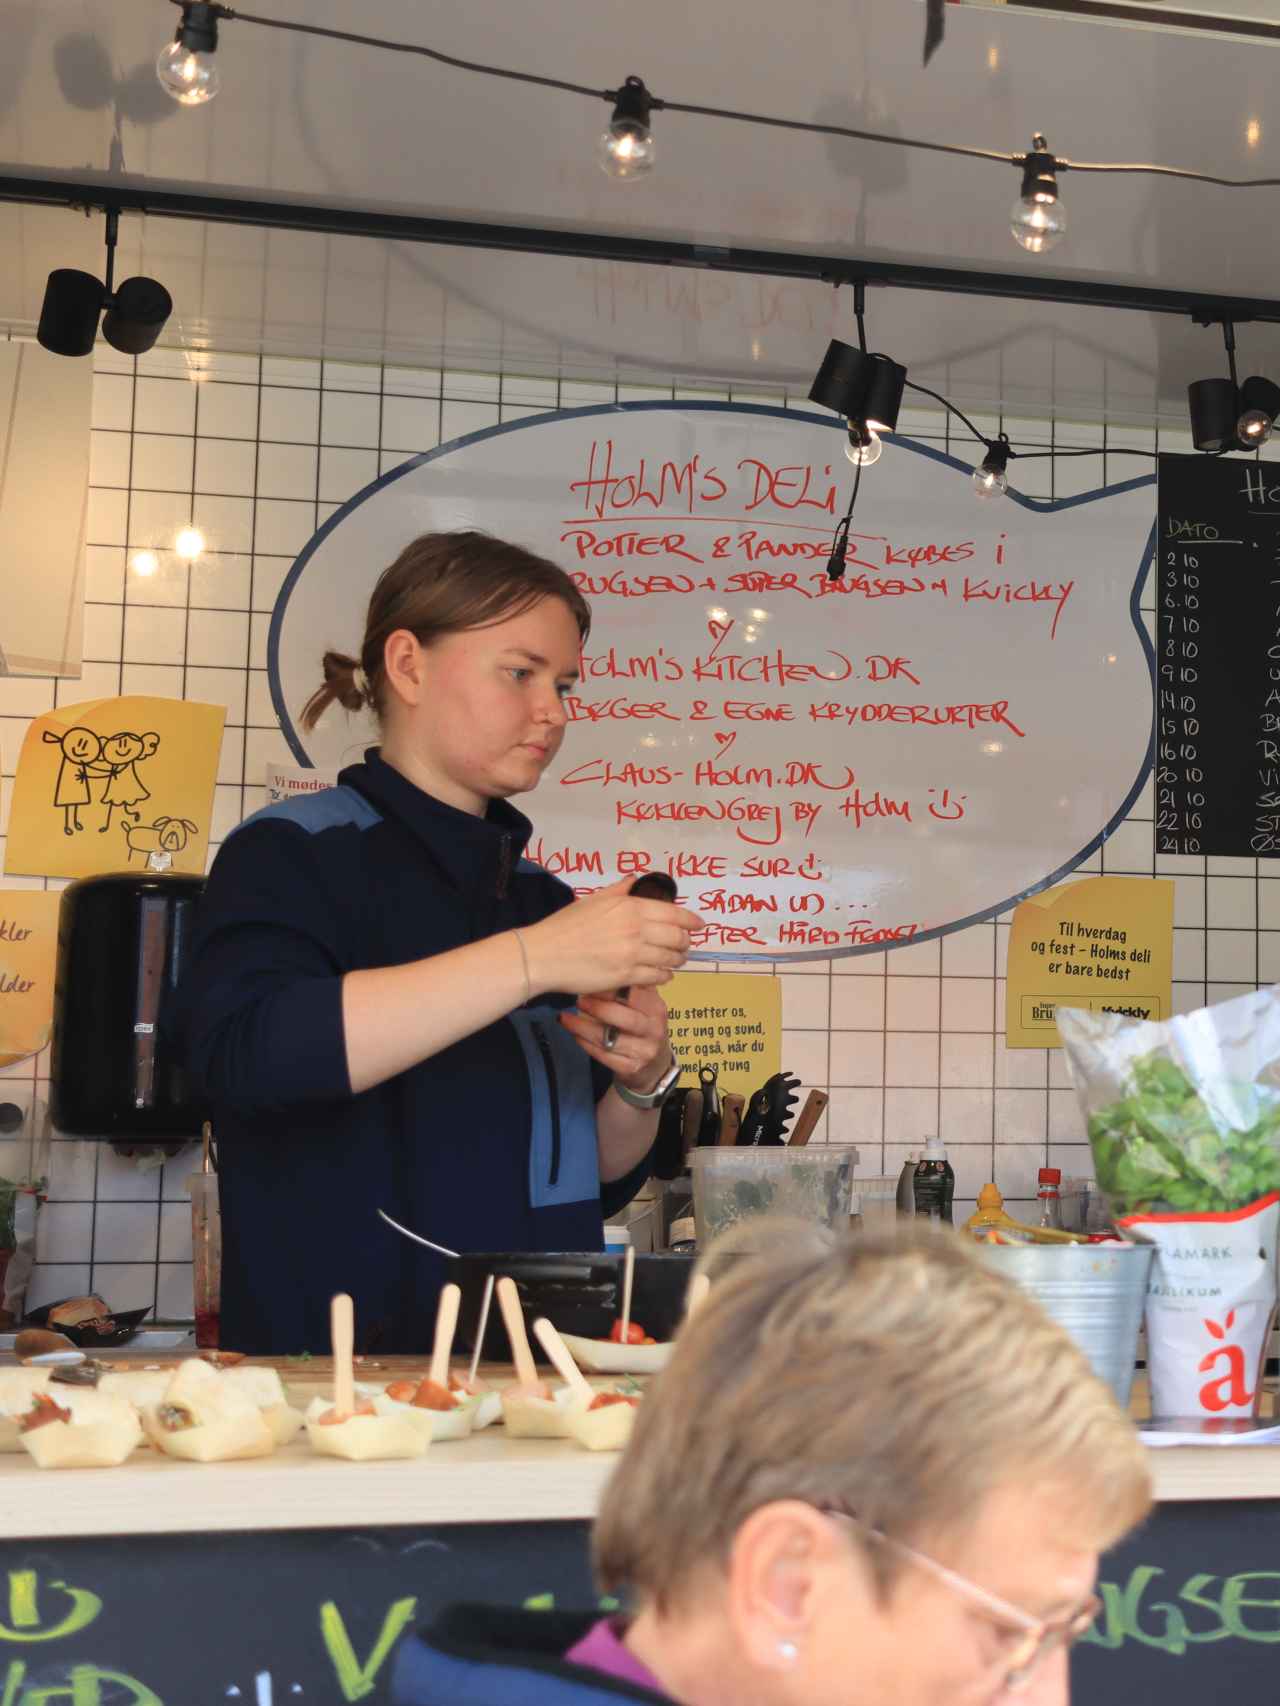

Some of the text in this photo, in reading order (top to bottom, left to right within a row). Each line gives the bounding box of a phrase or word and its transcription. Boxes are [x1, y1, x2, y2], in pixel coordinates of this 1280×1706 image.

[570, 440, 727, 518] HOLM'S
[1166, 518, 1220, 540] DATO
[712, 536, 733, 558] &
[689, 701, 718, 721] &
[723, 702, 796, 722] EGNE
[616, 850, 652, 874] ER
[738, 855, 798, 880] SUR
[1058, 921, 1128, 945] Til hverdag
[1030, 939, 1152, 964] og fest Holms deli
[1048, 961, 1132, 981] er bare bedst
[684, 1006, 728, 1019] støtter
[677, 1028, 689, 1037] er
[692, 1027, 715, 1039] ung
[718, 1025, 732, 1037] og
[727, 1040, 748, 1053] når
[751, 1039, 765, 1052] du
[722, 1060, 751, 1073] tung
